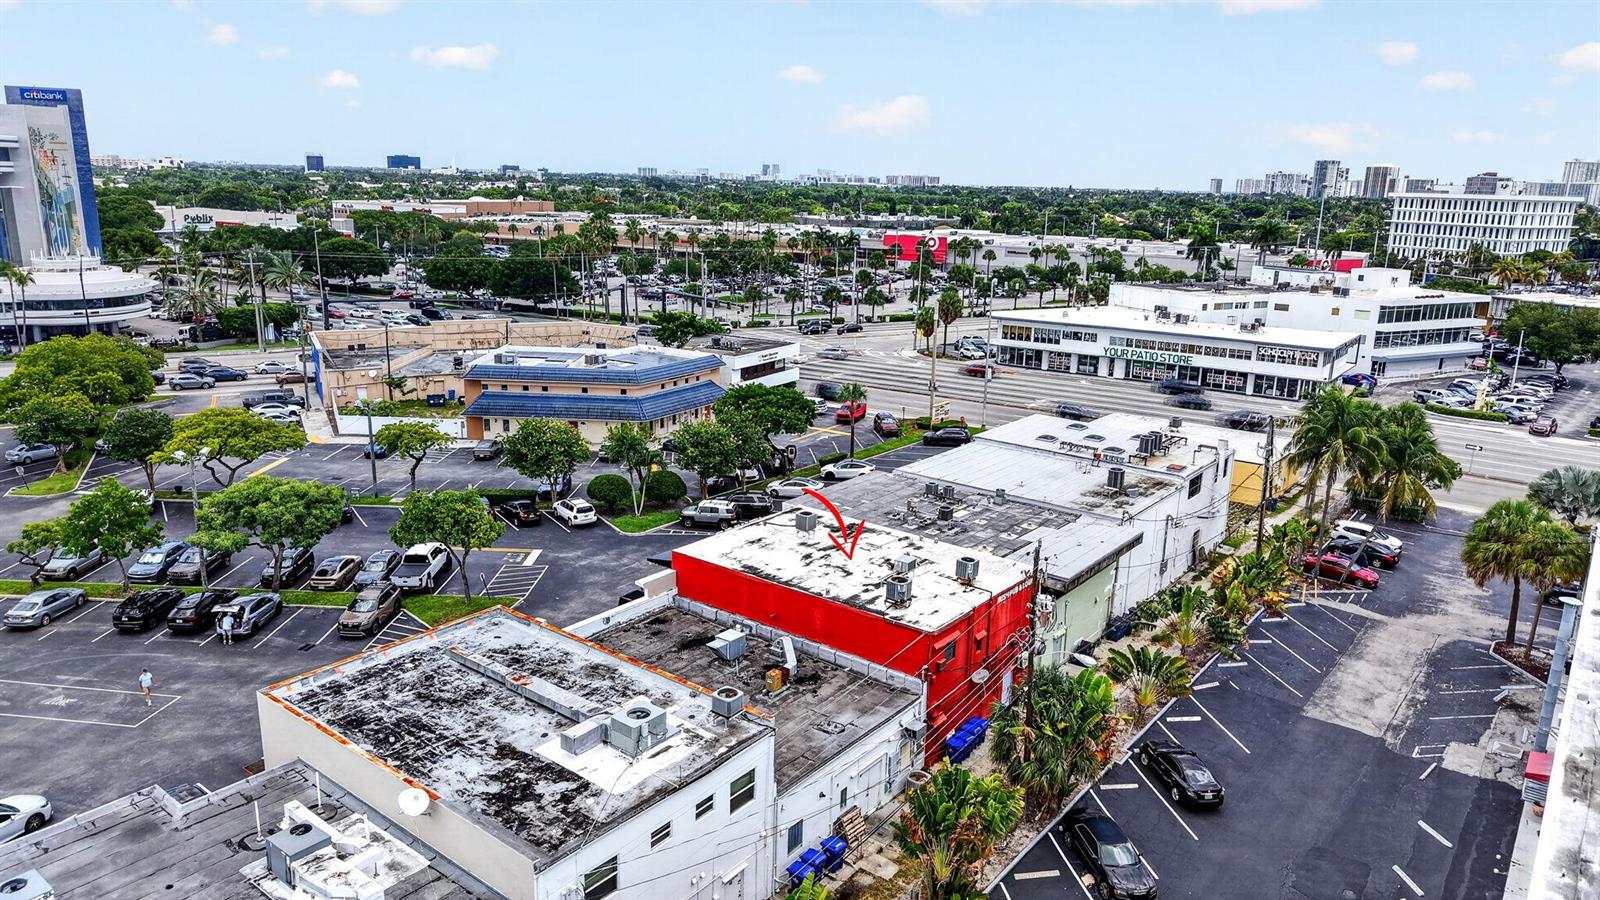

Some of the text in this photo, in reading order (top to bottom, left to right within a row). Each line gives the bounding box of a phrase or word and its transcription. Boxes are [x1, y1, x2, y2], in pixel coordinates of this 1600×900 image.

[24, 89, 63, 100] citibank
[183, 213, 214, 222] Publix
[1103, 347, 1129, 359] YOUR
[1130, 350, 1159, 362] PATIO
[1159, 353, 1194, 366] STORE
